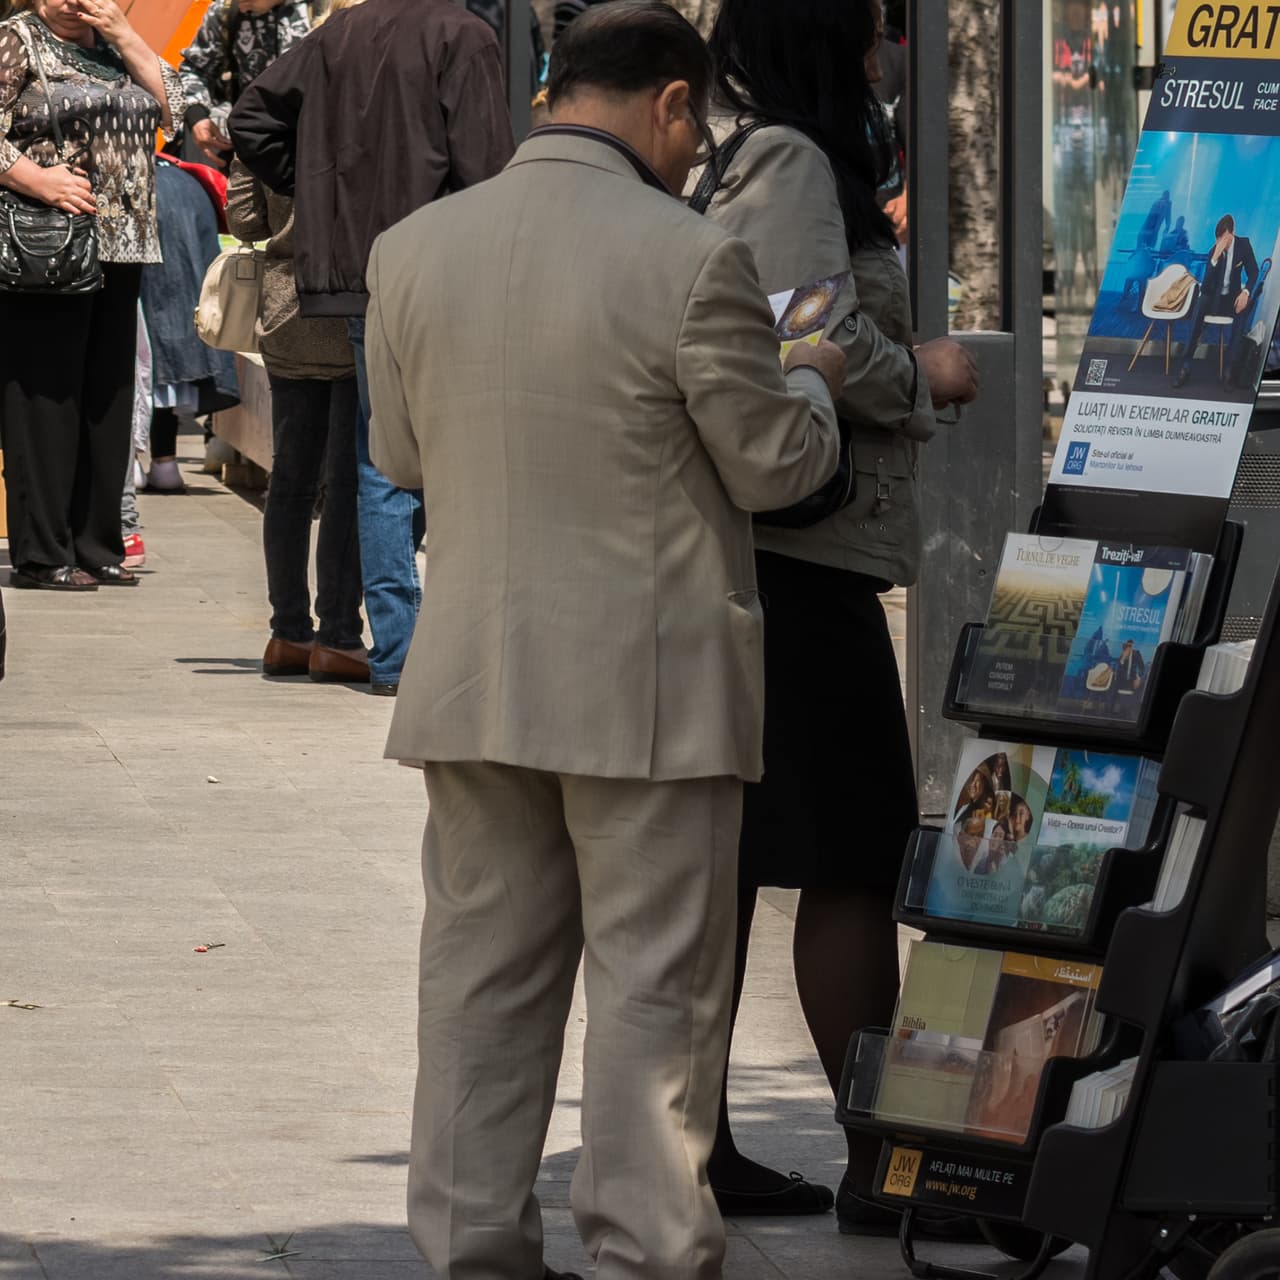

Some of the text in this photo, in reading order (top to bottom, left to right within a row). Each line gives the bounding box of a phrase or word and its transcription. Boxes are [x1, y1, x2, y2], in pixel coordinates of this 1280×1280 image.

[1160, 79, 1245, 110] STRESUL
[1257, 82, 1280, 95] CUM
[1253, 98, 1278, 111] FACE
[1077, 402, 1240, 428] LUAȚI UN EXEMPLAR GRATUIT
[1107, 426, 1133, 437] REVISTA
[1143, 428, 1164, 439] LIMBA
[1165, 430, 1222, 444] DUMNEAVOASTRĂ
[1046, 552, 1056, 564] DE
[1056, 554, 1081, 566] VEGHE
[1118, 606, 1161, 625] STRESUL
[901, 1016, 927, 1031] Biblia
[889, 1173, 912, 1188] ORG
[957, 1164, 973, 1178] MAI
[973, 1167, 1001, 1182] MULTE
[1002, 1172, 1016, 1185] PE
[925, 1179, 978, 1200] www.jw.org
